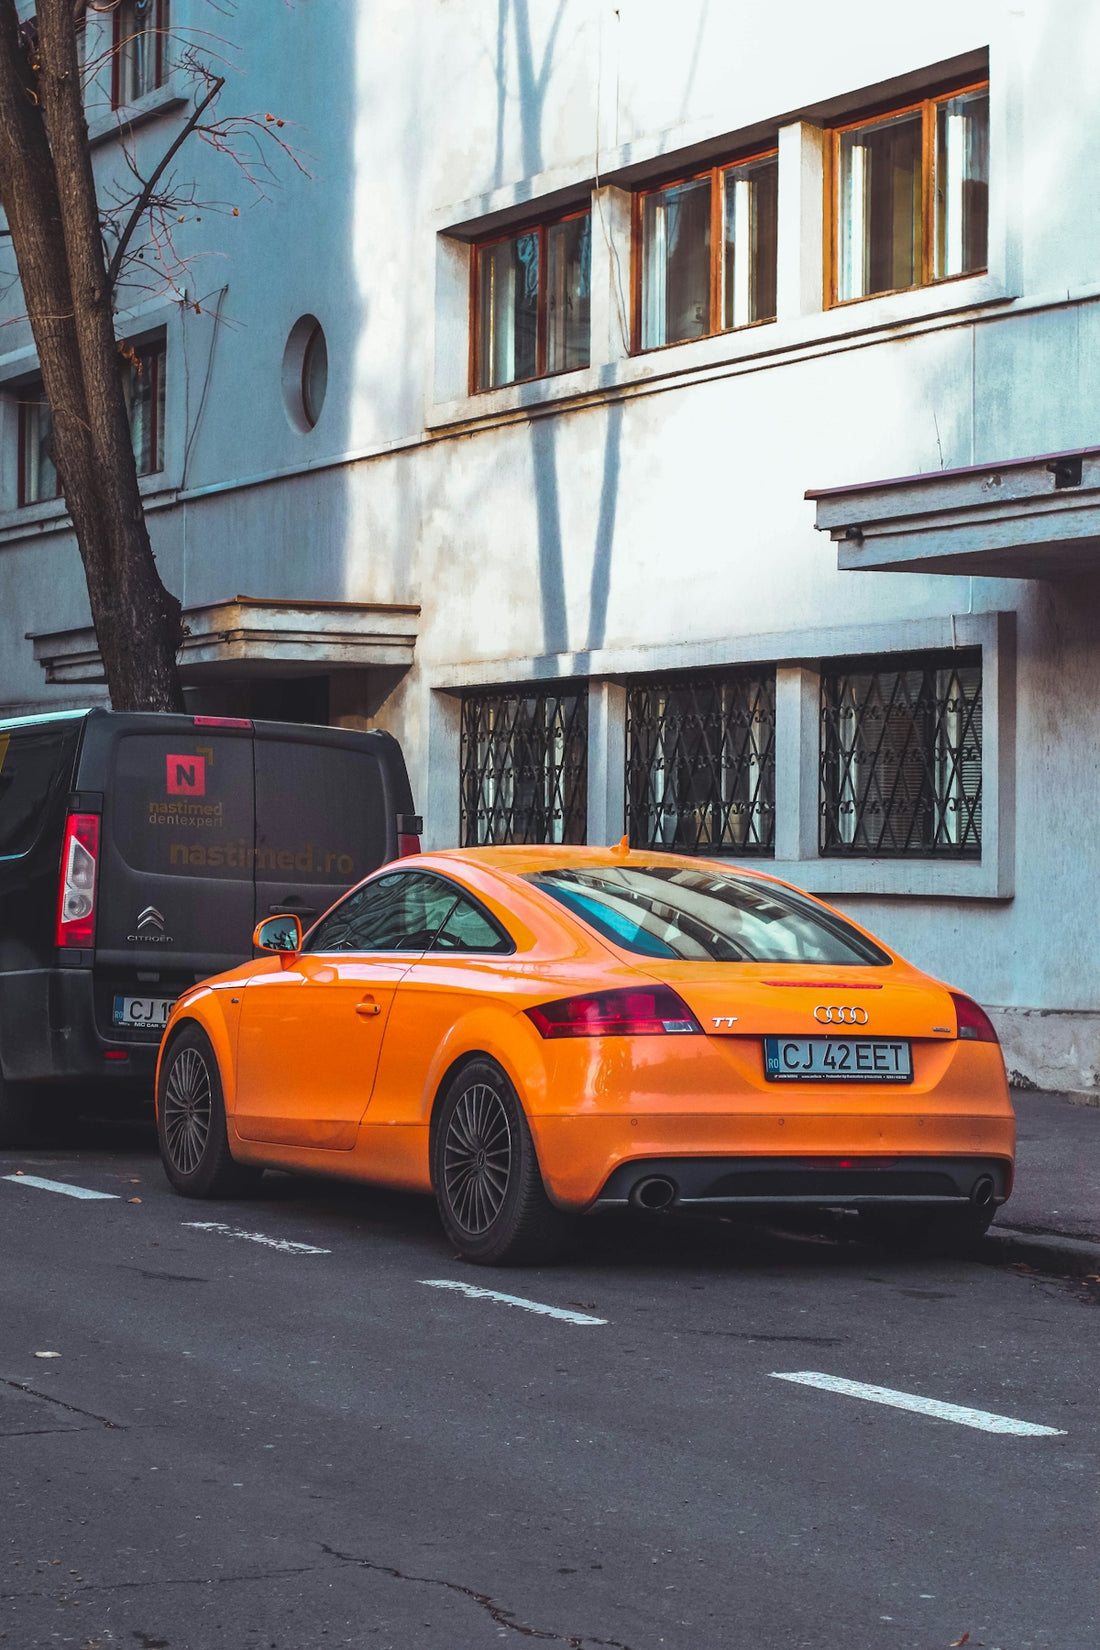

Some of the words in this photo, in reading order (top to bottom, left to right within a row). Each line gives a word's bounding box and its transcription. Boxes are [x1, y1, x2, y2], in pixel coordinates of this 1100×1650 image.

[176, 764, 196, 787] N
[149, 800, 223, 816] nastimed
[149, 812, 223, 828] dentexpert
[169, 839, 355, 875] nastimed.ro
[114, 1010, 124, 1020] RO
[129, 1000, 154, 1021] CJ
[712, 1017, 738, 1028] TT
[768, 1058, 780, 1069] RO
[783, 1043, 813, 1070] CJ
